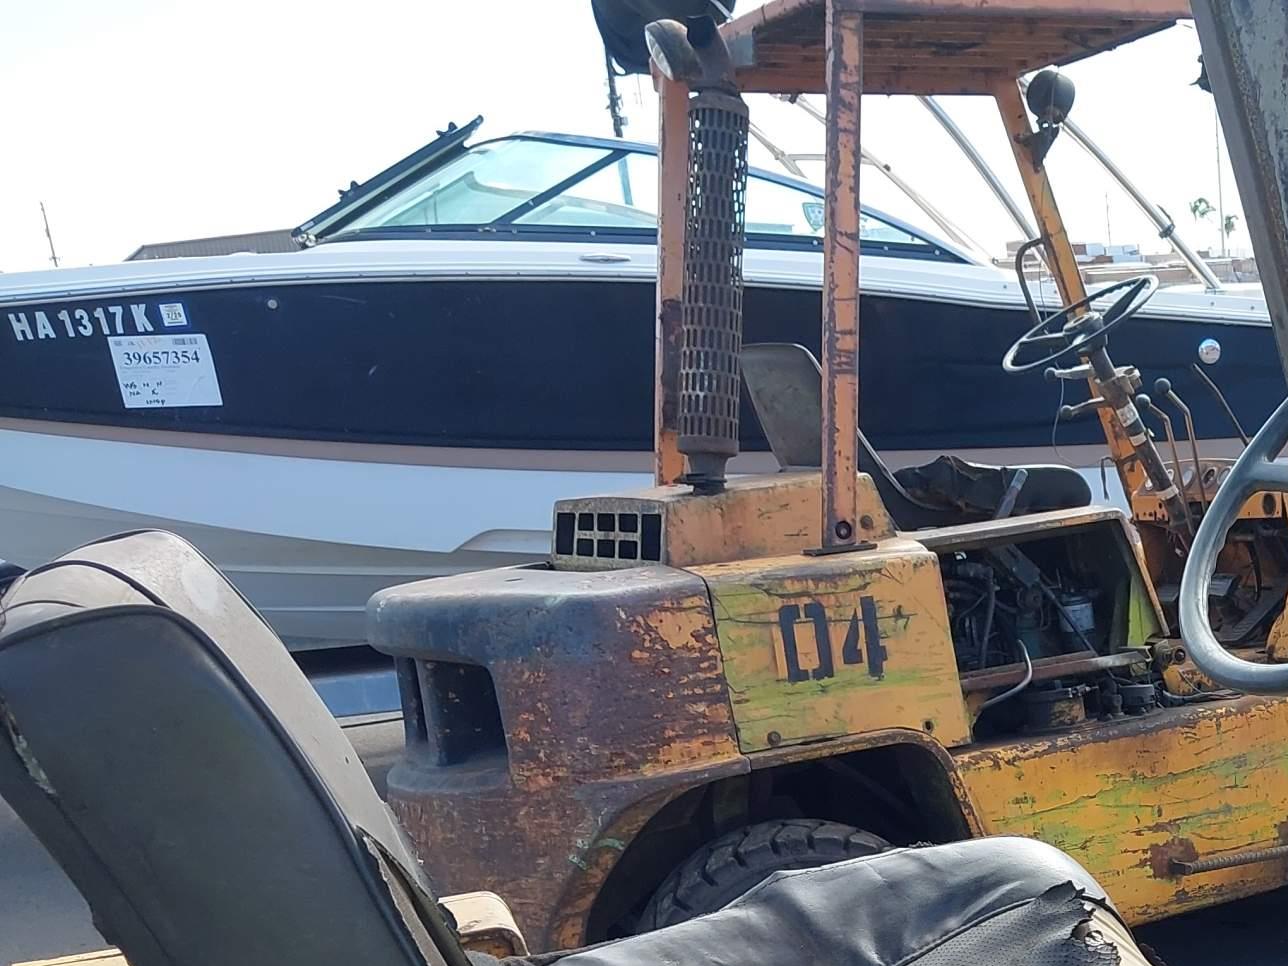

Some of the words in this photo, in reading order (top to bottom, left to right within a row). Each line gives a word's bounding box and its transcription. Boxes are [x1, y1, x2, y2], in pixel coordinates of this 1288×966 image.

[8, 311, 56, 341] HA
[57, 305, 124, 338] 1317
[130, 303, 154, 333] K
[122, 350, 200, 366] 39657354
[779, 596, 888, 682] 04
